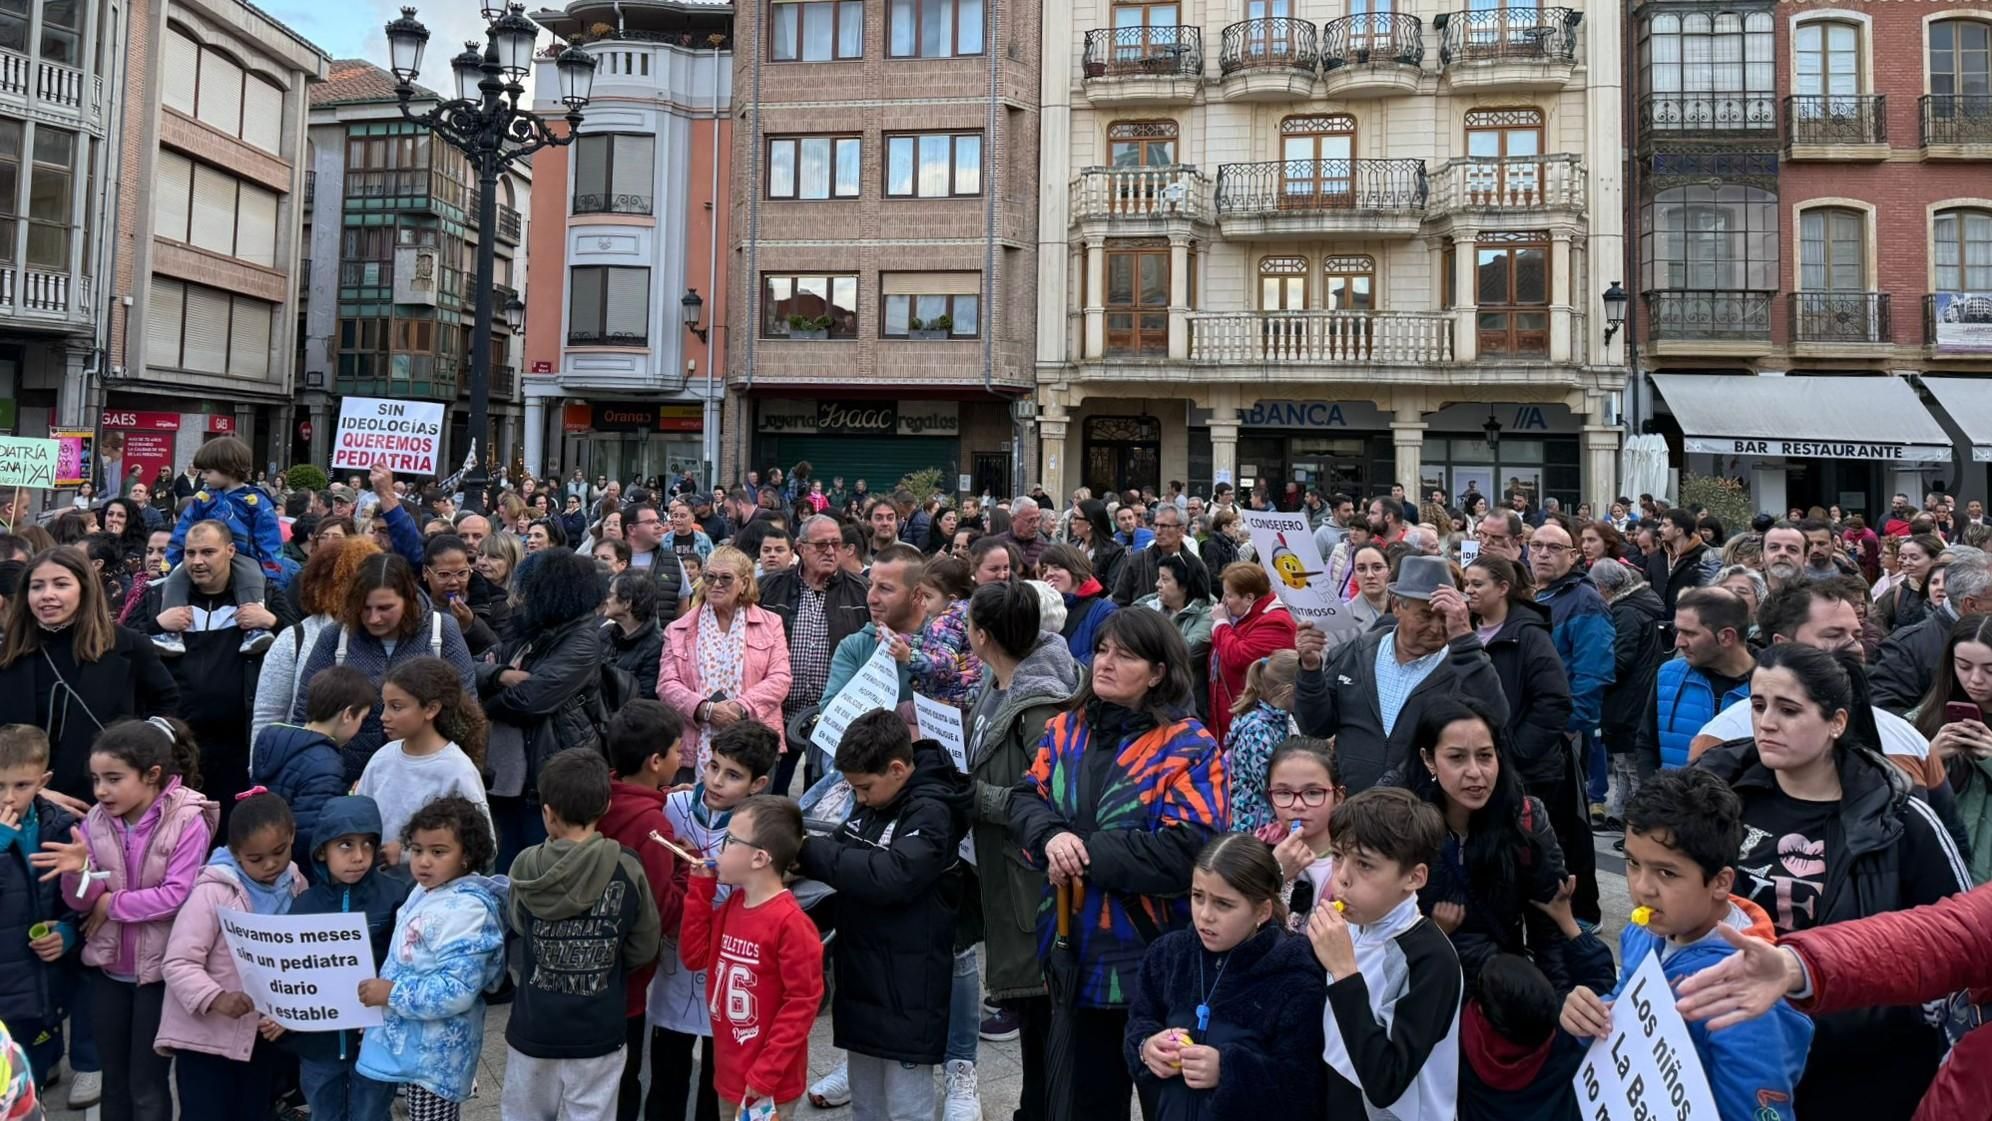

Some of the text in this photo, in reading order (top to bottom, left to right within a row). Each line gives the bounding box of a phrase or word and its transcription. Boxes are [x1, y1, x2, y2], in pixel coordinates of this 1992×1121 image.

[102, 413, 137, 426] GAES
[377, 403, 405, 417] SIN
[341, 416, 439, 436] IDEOLOGÍAS
[899, 413, 957, 432] regalos
[342, 432, 432, 453] QUEREMOS
[1734, 441, 1903, 459] BAR RESTAURANTE
[335, 449, 432, 472] PEDIATRÍA
[1250, 518, 1304, 532] CONSEJERO
[1288, 603, 1336, 617] ENTIROSO
[224, 919, 362, 943] Llevamos meses
[236, 947, 358, 972] sin un pediatra
[270, 980, 318, 995] diario
[276, 1006, 339, 1021] estable
[1631, 977, 1691, 1121] Los niños
[1583, 1061, 1600, 1102] no
[1611, 1031, 1657, 1121] La Ba
